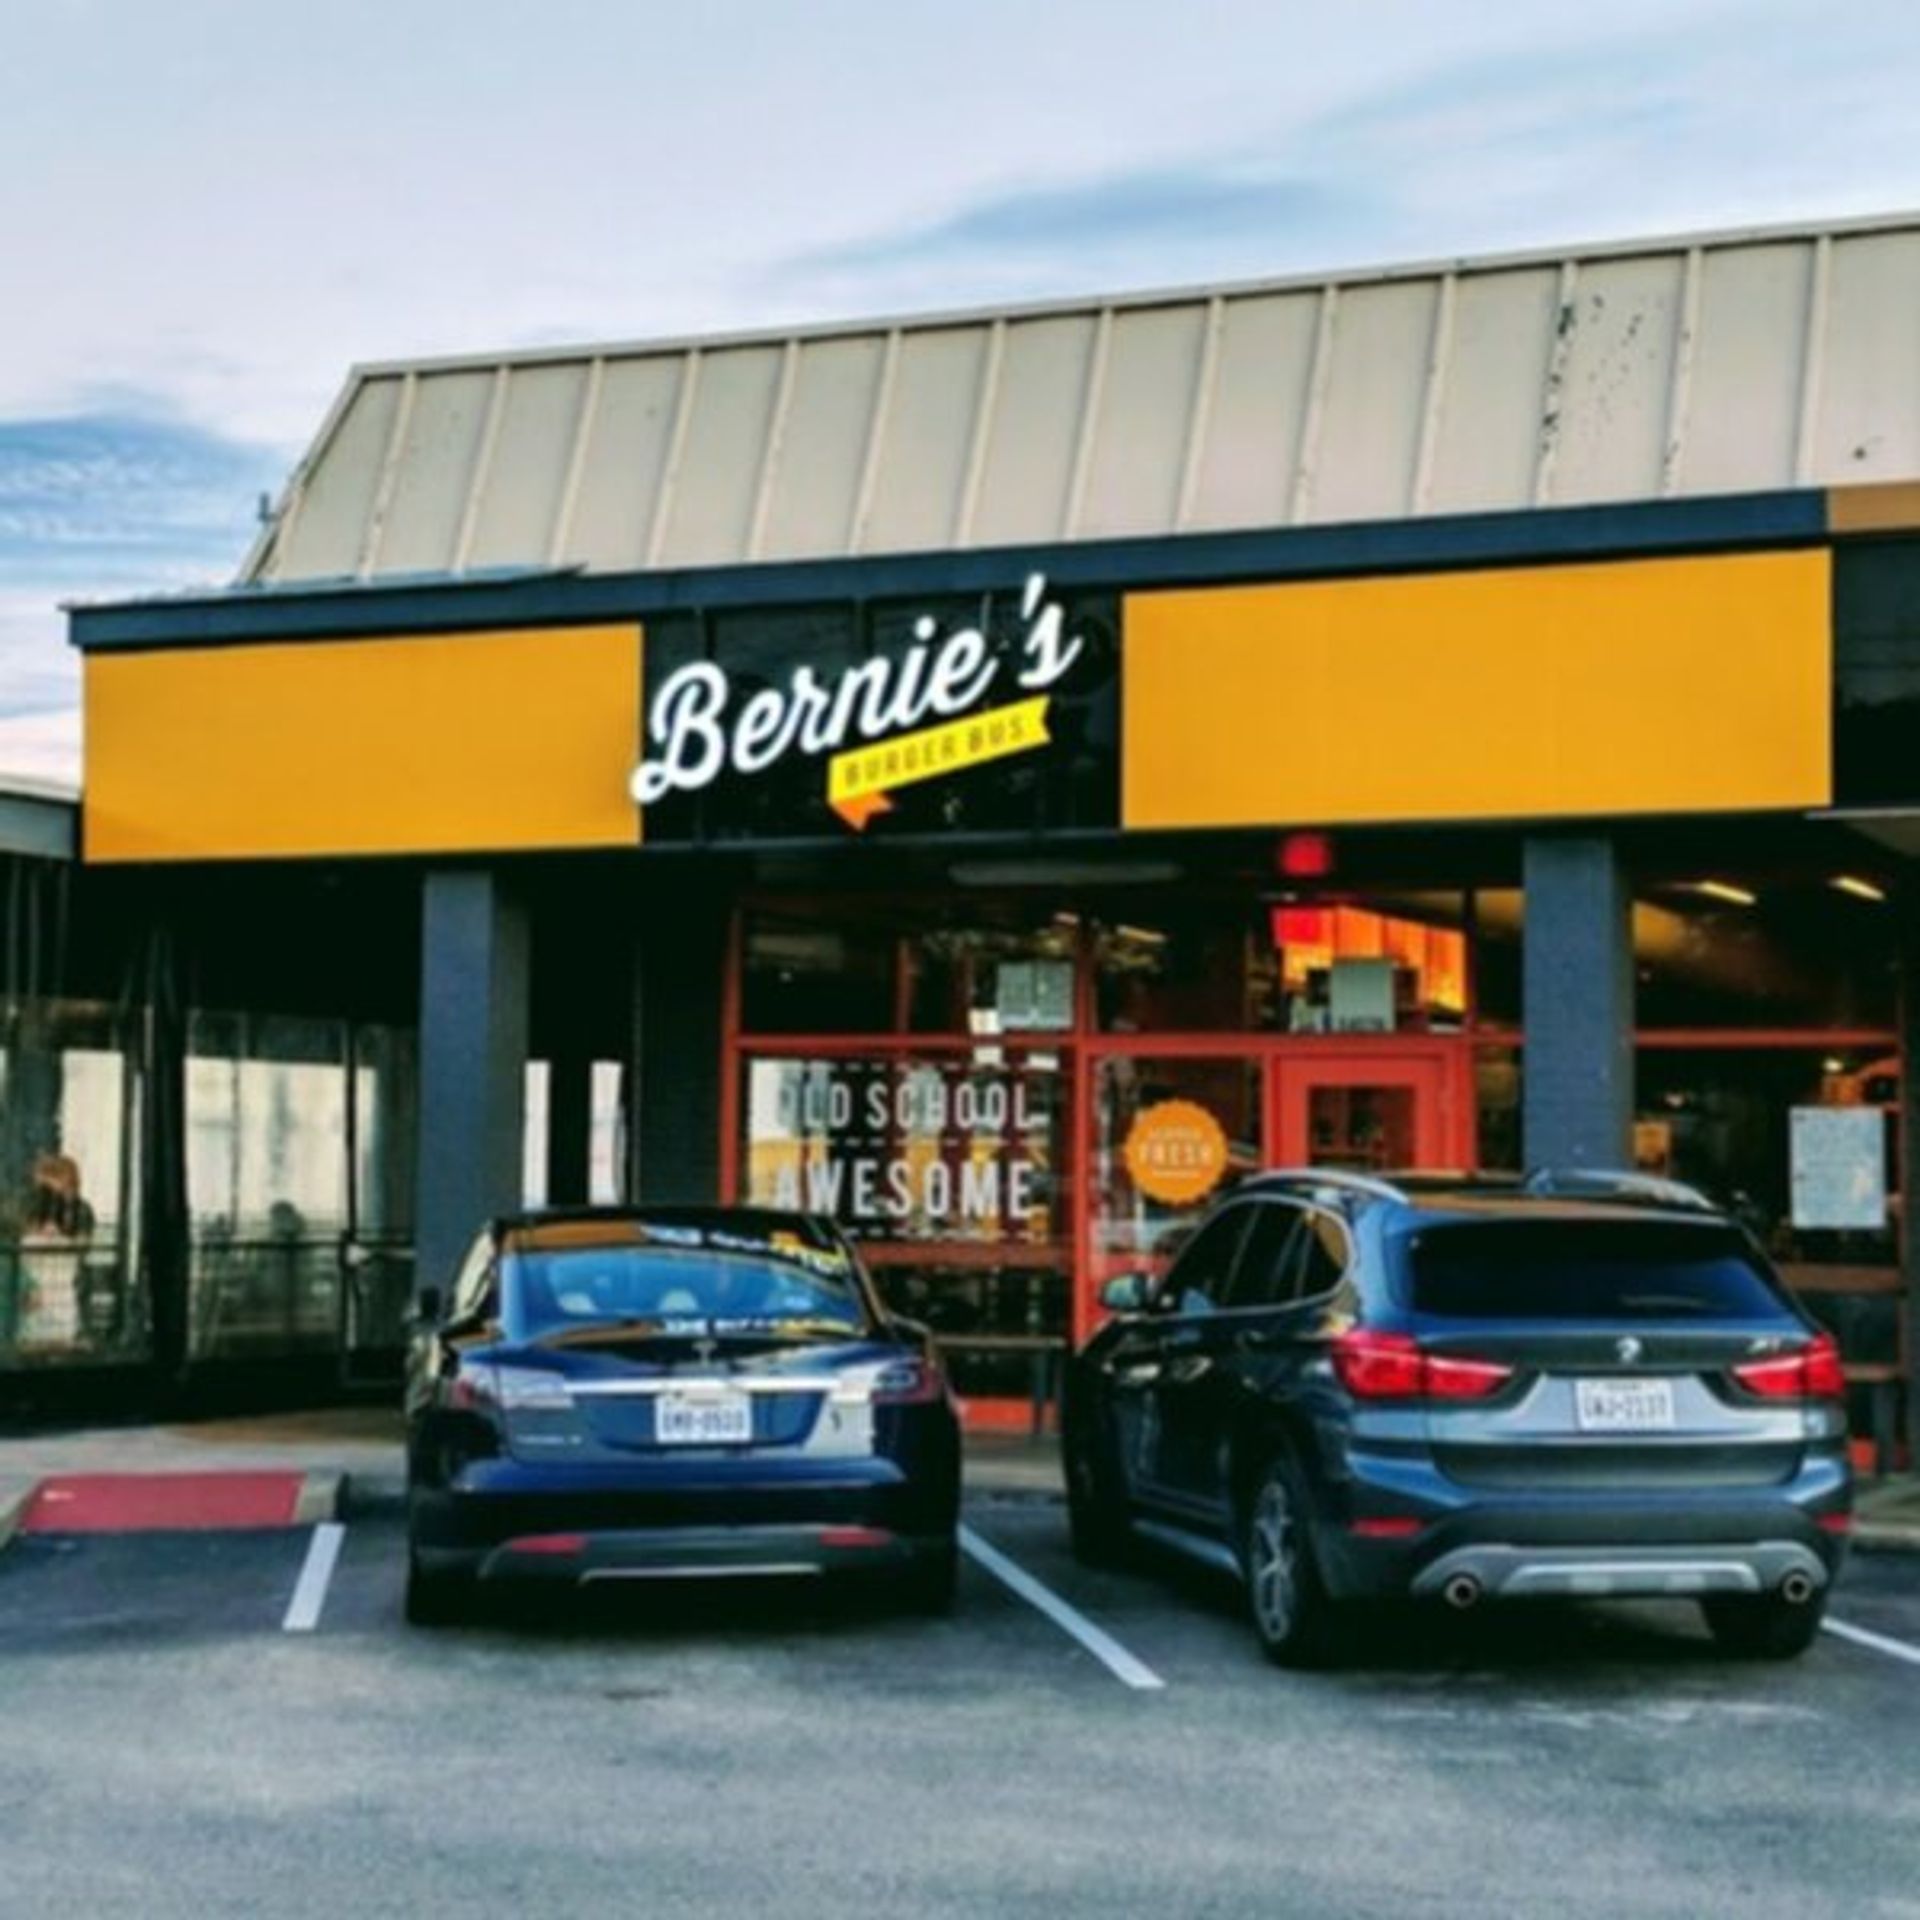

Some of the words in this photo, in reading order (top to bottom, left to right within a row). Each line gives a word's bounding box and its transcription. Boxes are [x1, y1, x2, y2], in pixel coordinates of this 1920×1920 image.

[630, 572, 1084, 804] Bernie's
[844, 733, 956, 790] BURGER
[967, 713, 1026, 754] BUS
[866, 1081, 1034, 1129] SCHOOL
[774, 1158, 1034, 1218] AWESOME
